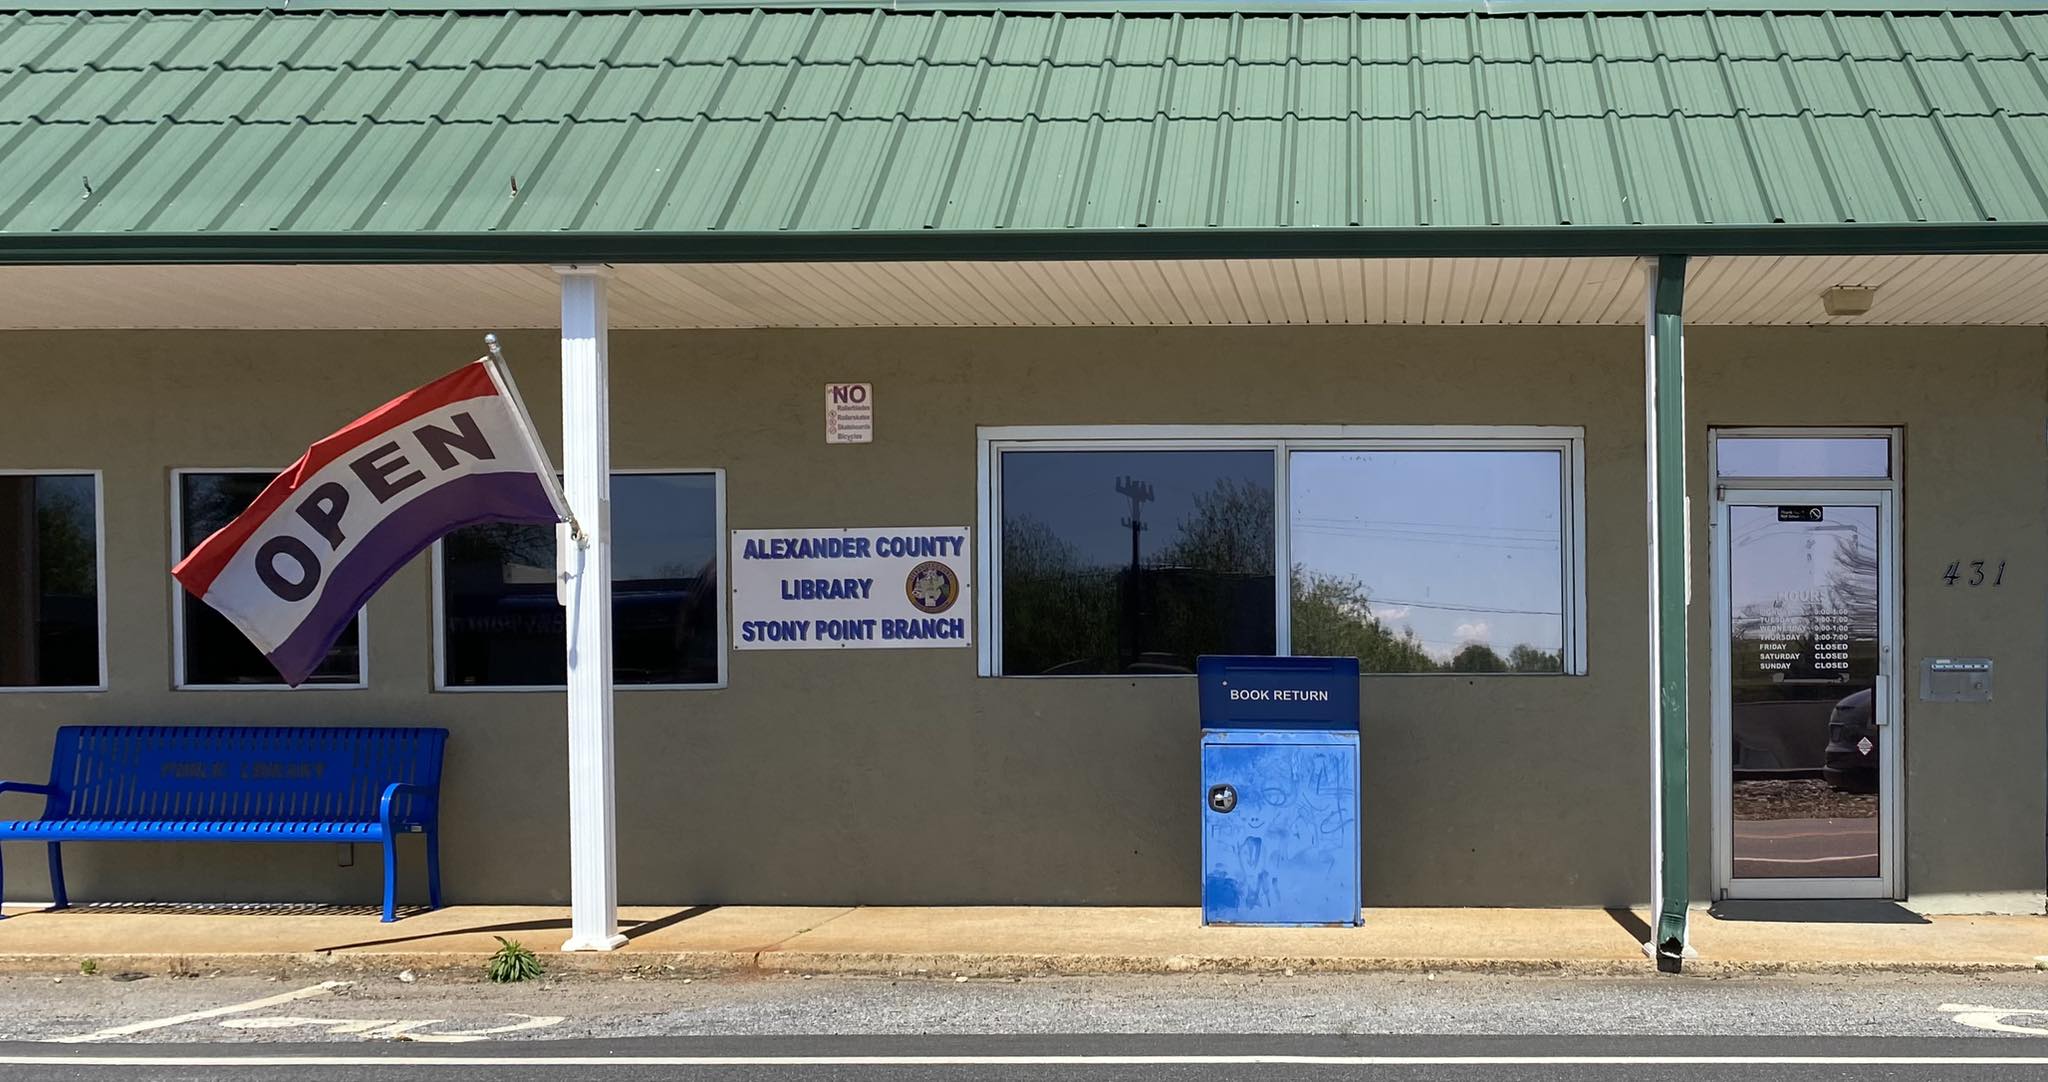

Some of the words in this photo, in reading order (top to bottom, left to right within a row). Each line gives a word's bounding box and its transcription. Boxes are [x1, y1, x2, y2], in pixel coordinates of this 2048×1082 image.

[833, 384, 867, 404] NO
[255, 411, 496, 602] OPEN
[743, 537, 871, 560] ALEXANDER
[875, 535, 965, 558] COUNTY
[1942, 560, 2007, 587] 431
[781, 578, 873, 600] LIBRARY
[1776, 591, 1827, 602] HOURS
[742, 620, 810, 642] STONY
[815, 619, 877, 640] POINT
[881, 618, 965, 640] BRANCH
[1760, 633, 1801, 641] THURSDAY
[1814, 633, 1849, 641] 3:00-7:00
[1760, 643, 1787, 651] FRIDAY
[1814, 643, 1849, 651] CLOSED
[1760, 652, 1801, 660] SATURDAY
[1814, 652, 1849, 660] CLOSED
[1760, 662, 1792, 670] SUNDAY
[1230, 689, 1270, 701] BOOK
[1273, 690, 1328, 701] RETURN
